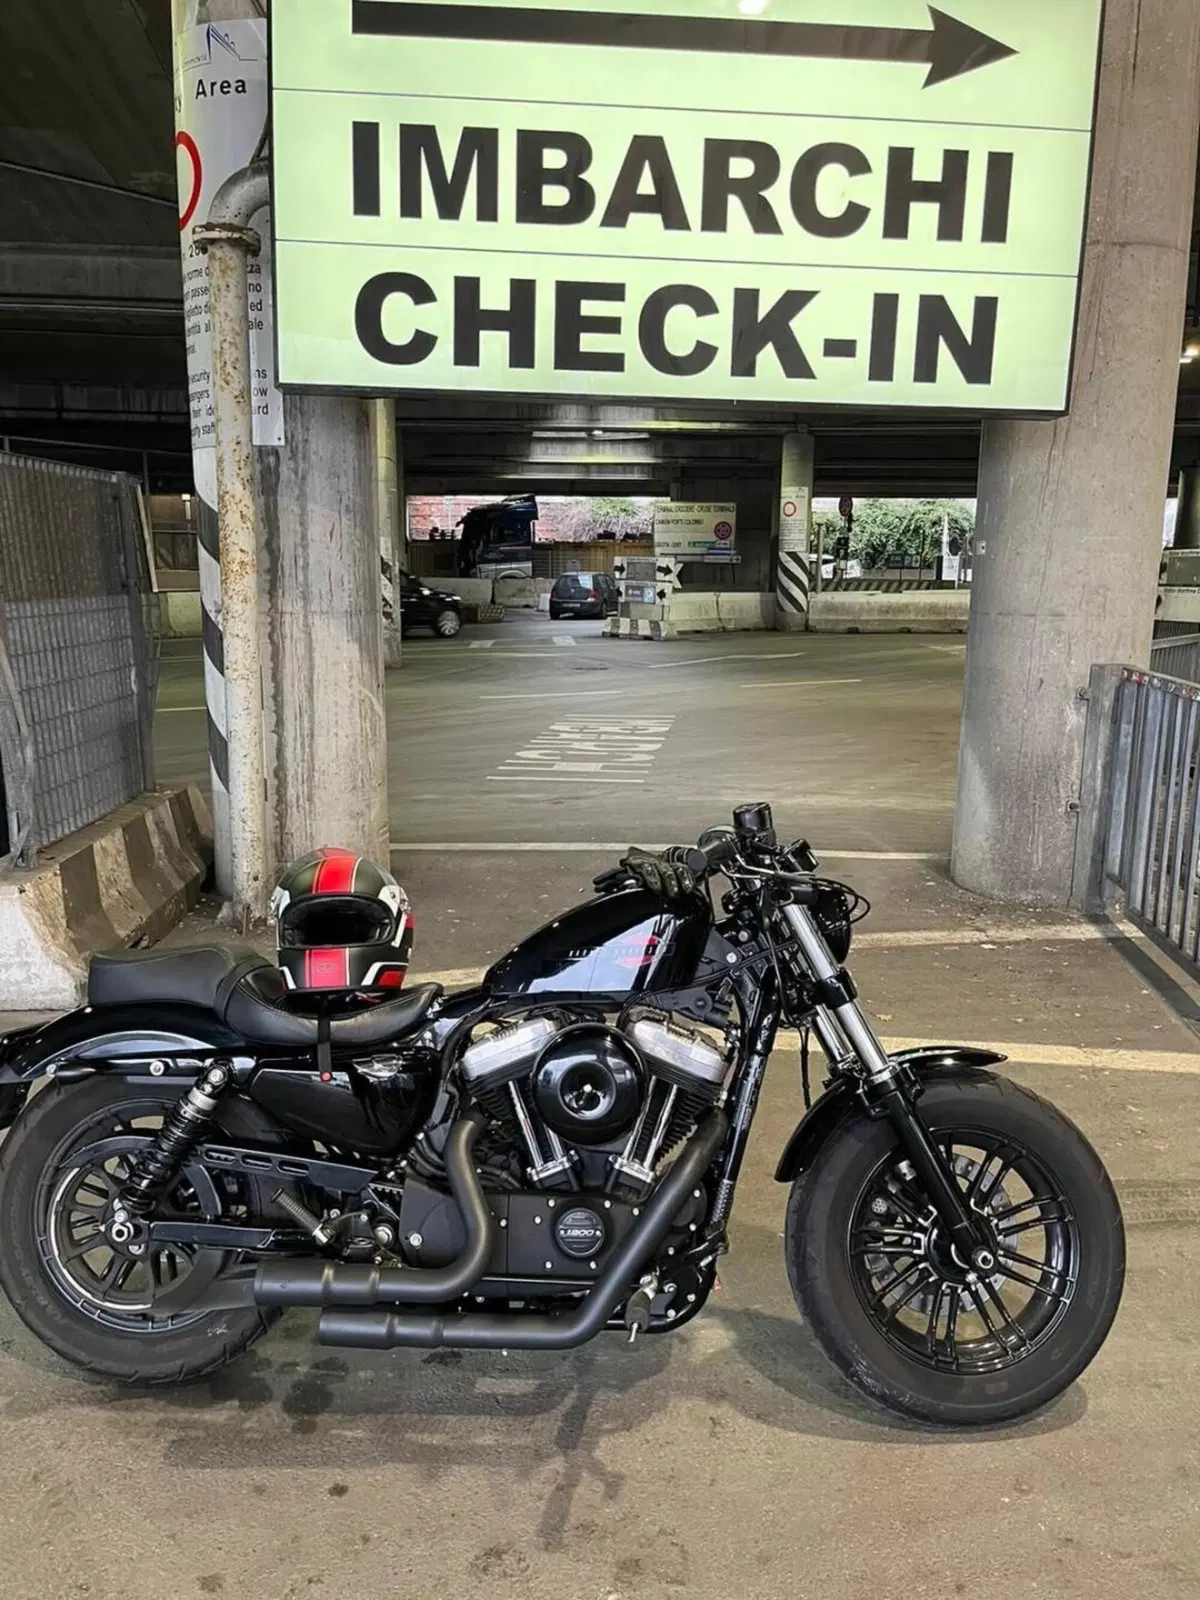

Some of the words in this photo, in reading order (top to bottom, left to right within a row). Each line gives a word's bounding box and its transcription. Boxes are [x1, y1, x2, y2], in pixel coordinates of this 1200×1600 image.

[195, 79, 247, 100] Area
[351, 121, 1014, 244] IMBARCHI
[354, 271, 999, 386] CHECK-IN
